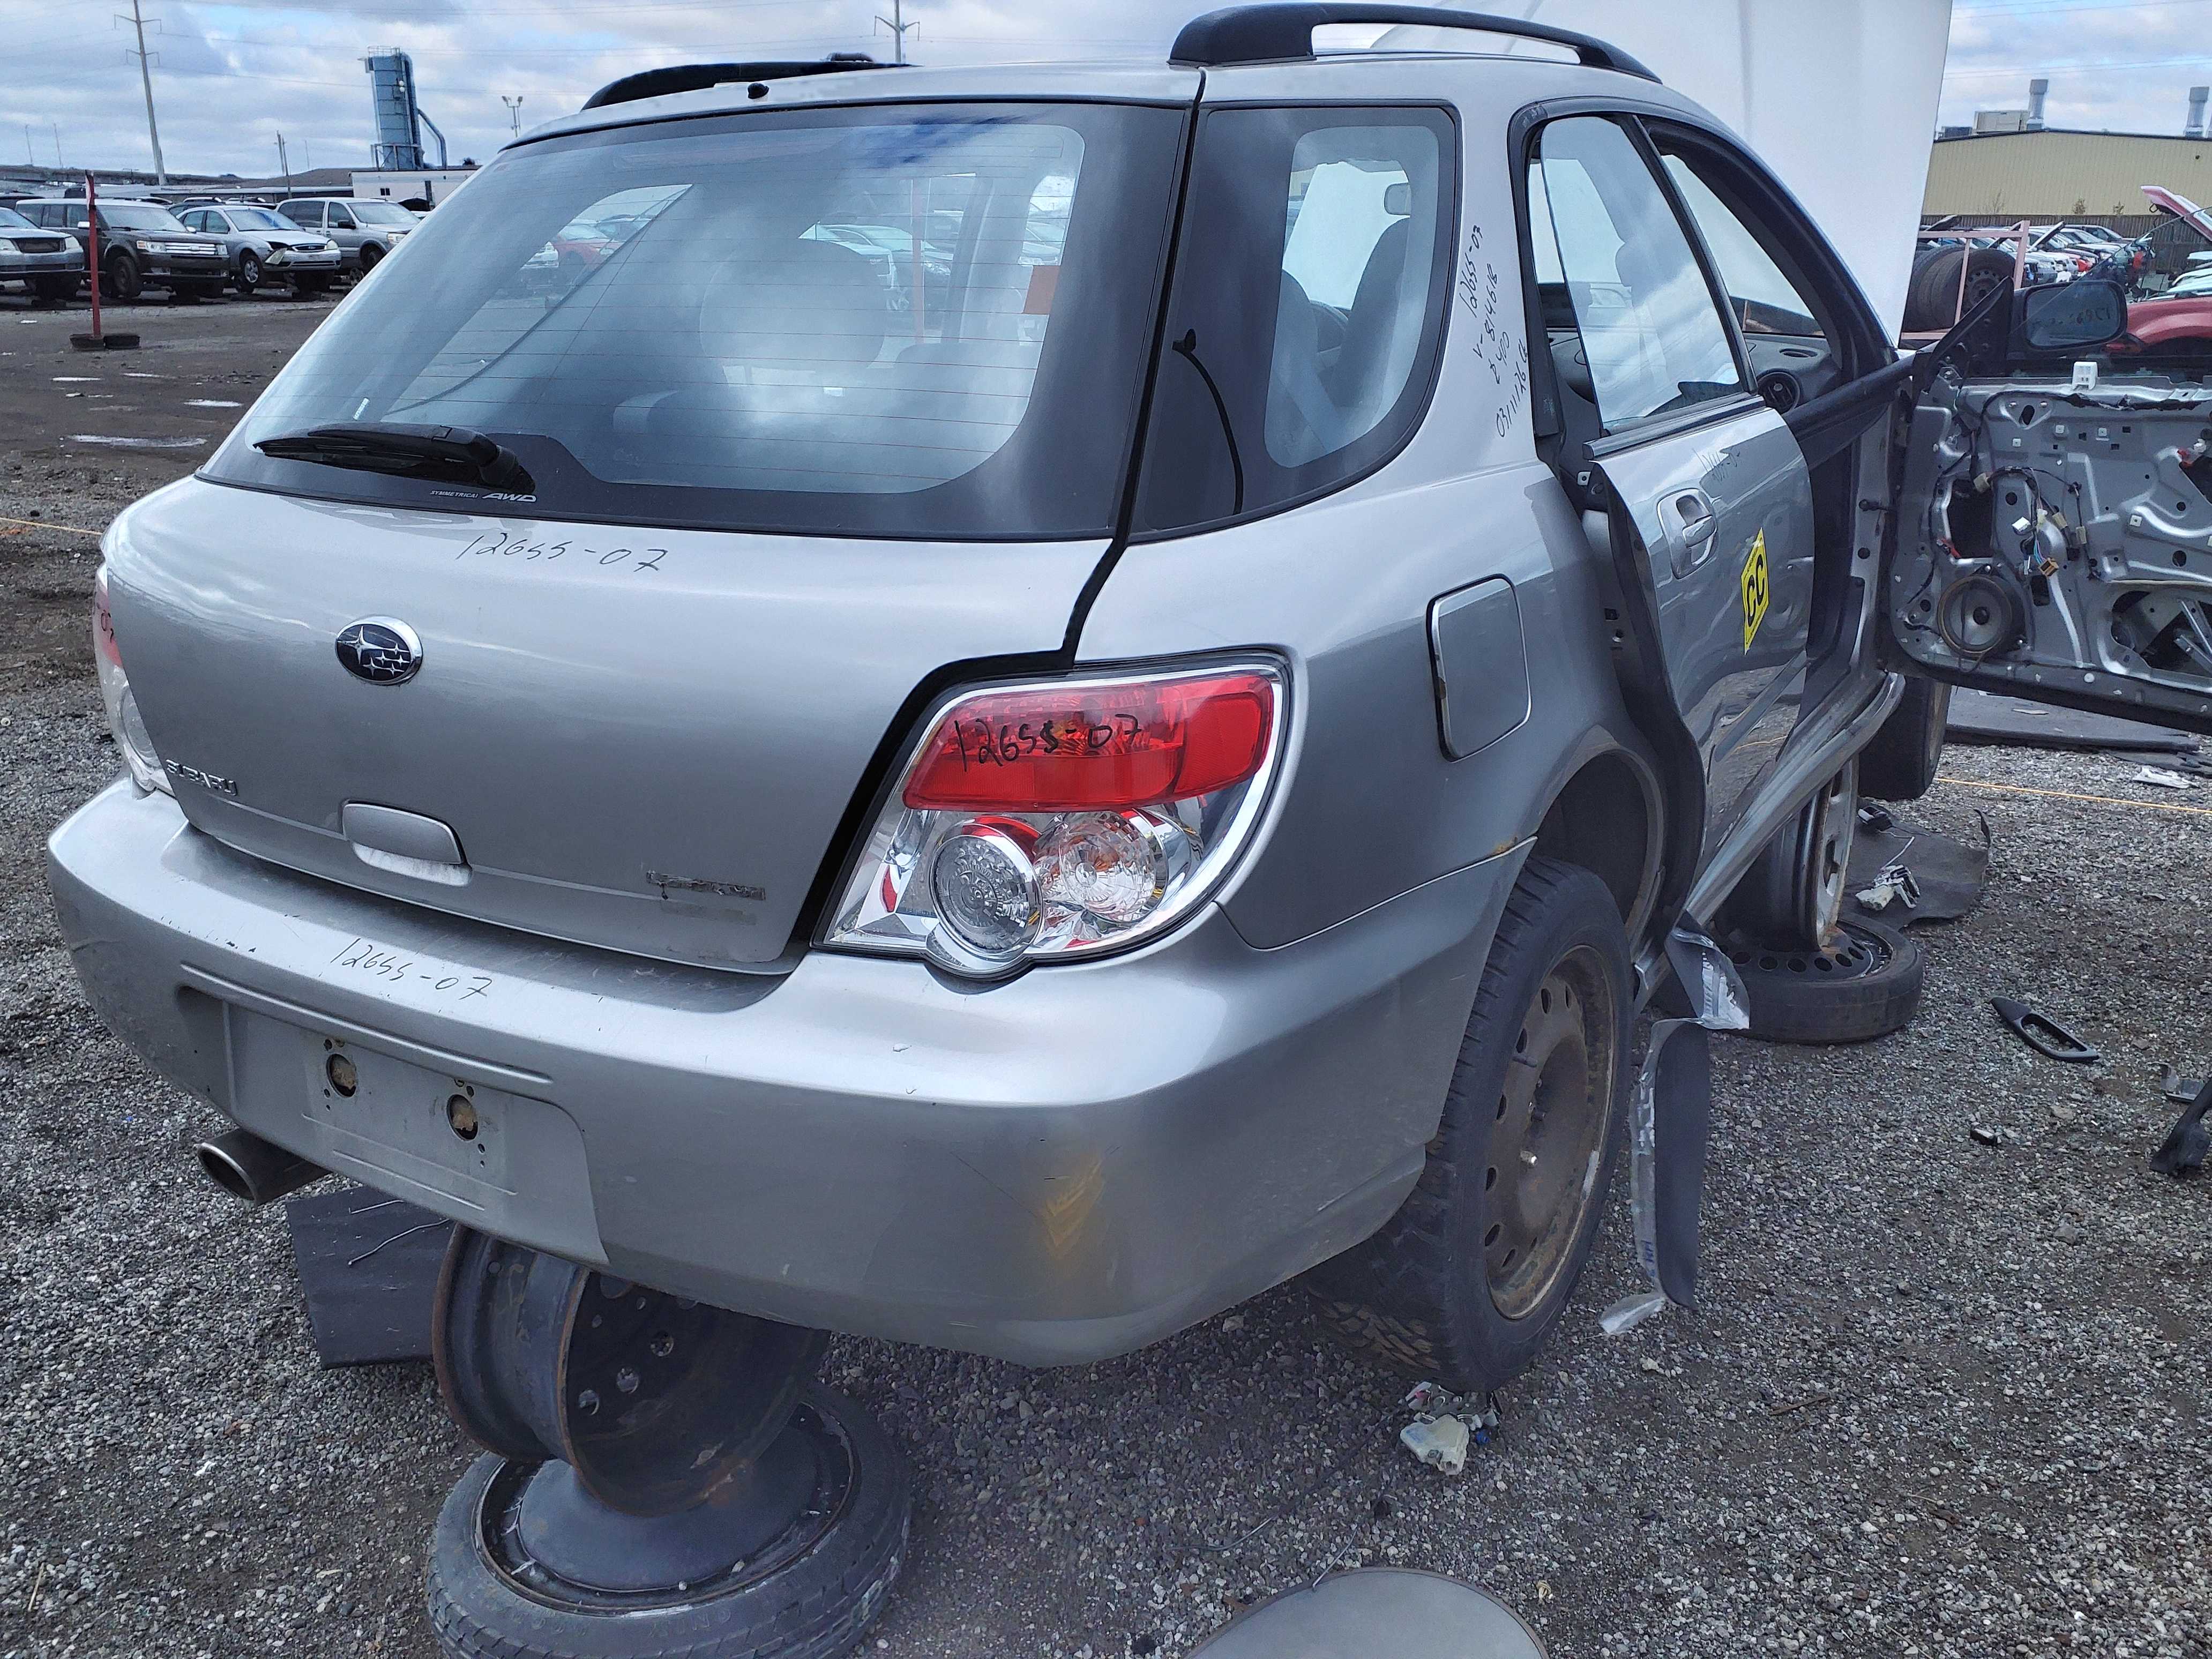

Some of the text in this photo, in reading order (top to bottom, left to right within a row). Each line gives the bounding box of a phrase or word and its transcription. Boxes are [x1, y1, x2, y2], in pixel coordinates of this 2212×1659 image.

[482, 492, 536, 503] AWD
[1746, 554, 1766, 627] CC
[954, 713, 1142, 772] 12655-07
